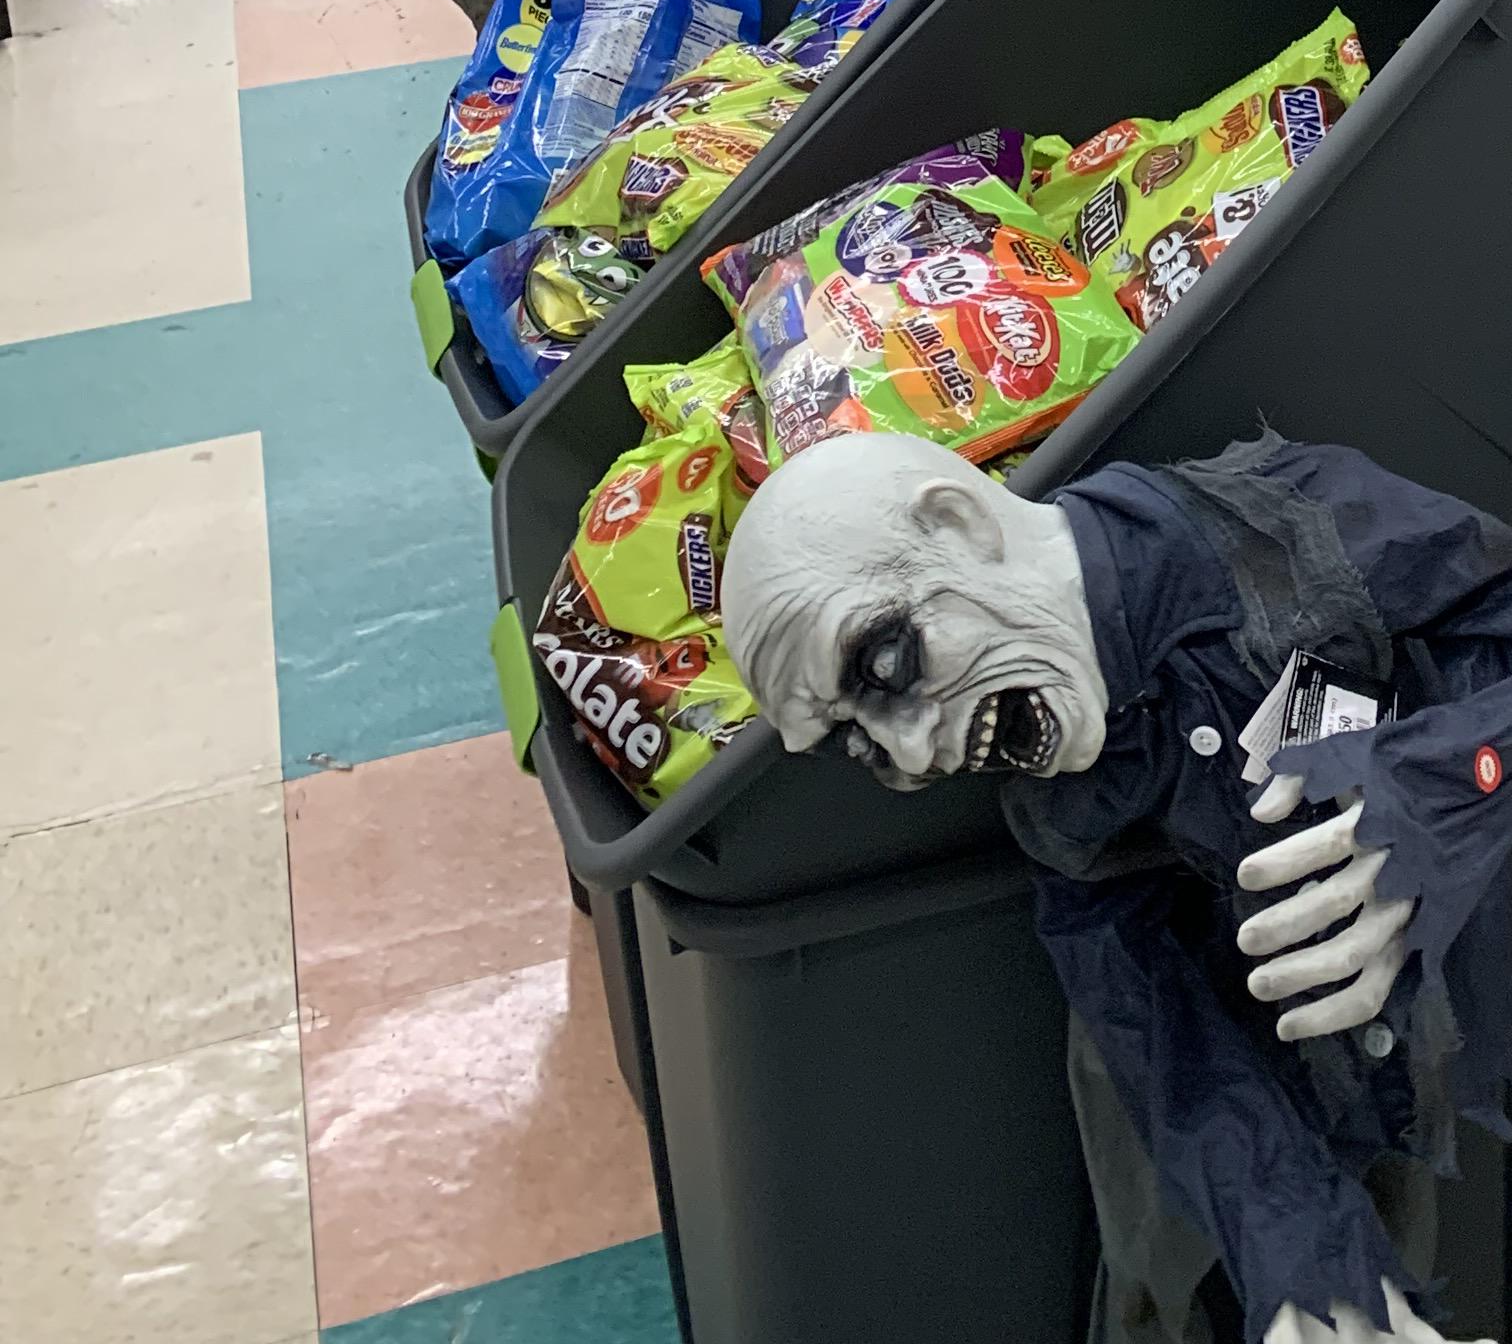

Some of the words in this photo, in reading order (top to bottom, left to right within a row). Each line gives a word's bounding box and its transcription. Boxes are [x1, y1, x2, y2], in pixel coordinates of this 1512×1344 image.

[494, 78, 523, 93] CRU
[927, 255, 974, 297] 100
[929, 347, 976, 406] Duds
[686, 527, 715, 610] NICKERS
